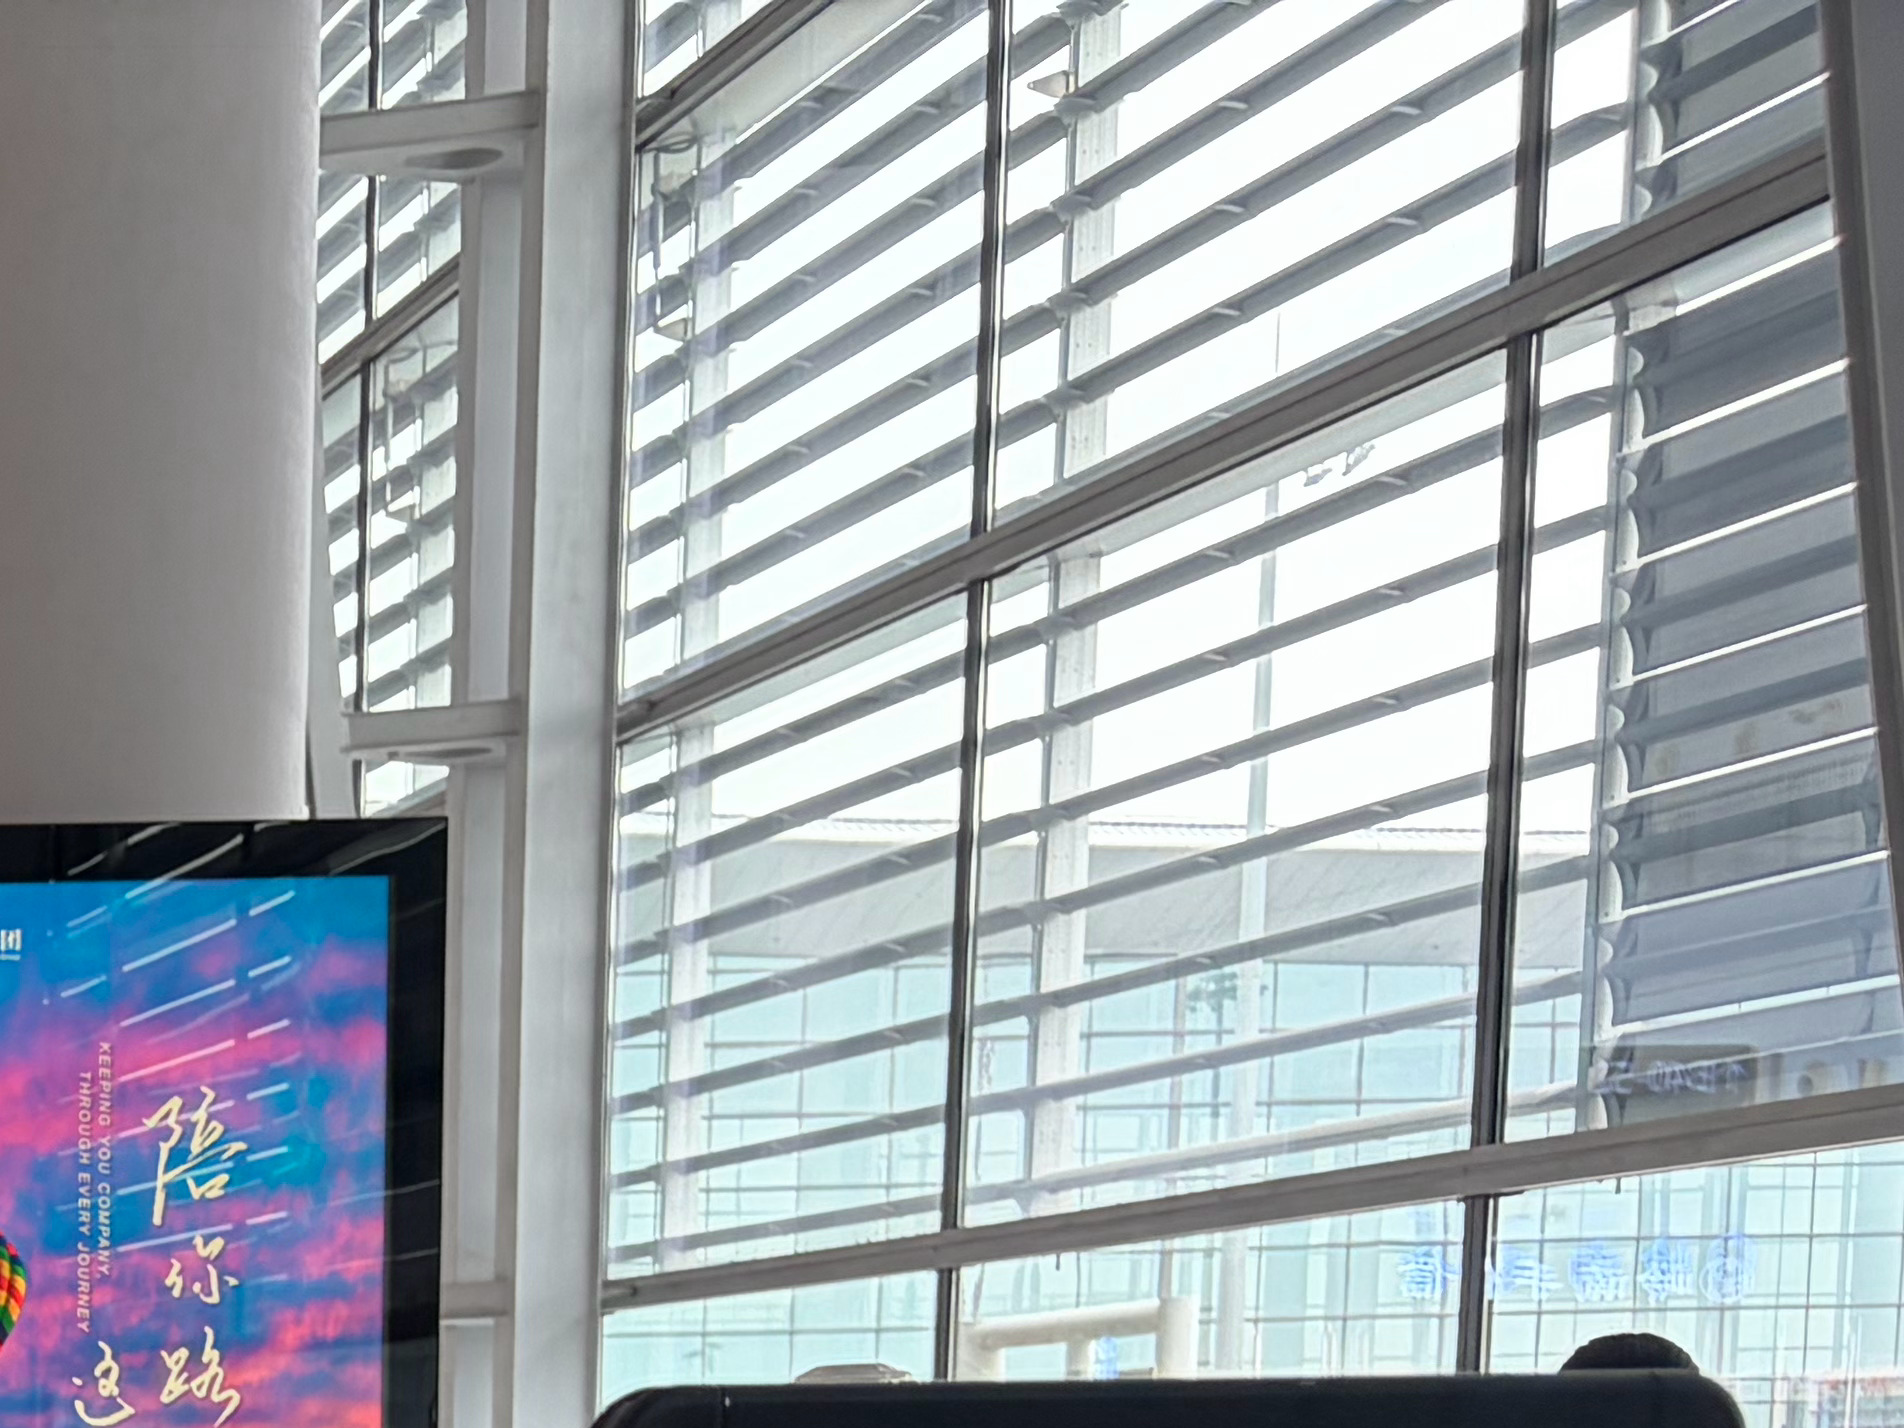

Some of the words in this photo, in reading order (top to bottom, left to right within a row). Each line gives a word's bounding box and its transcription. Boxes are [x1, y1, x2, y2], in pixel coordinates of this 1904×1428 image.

[78, 1072, 93, 1164] THROUGH
[98, 1042, 112, 1126] KEEPING
[97, 1136, 111, 1175] YOU
[77, 1172, 92, 1236] EVERY
[76, 1242, 92, 1332] JOURNEY
